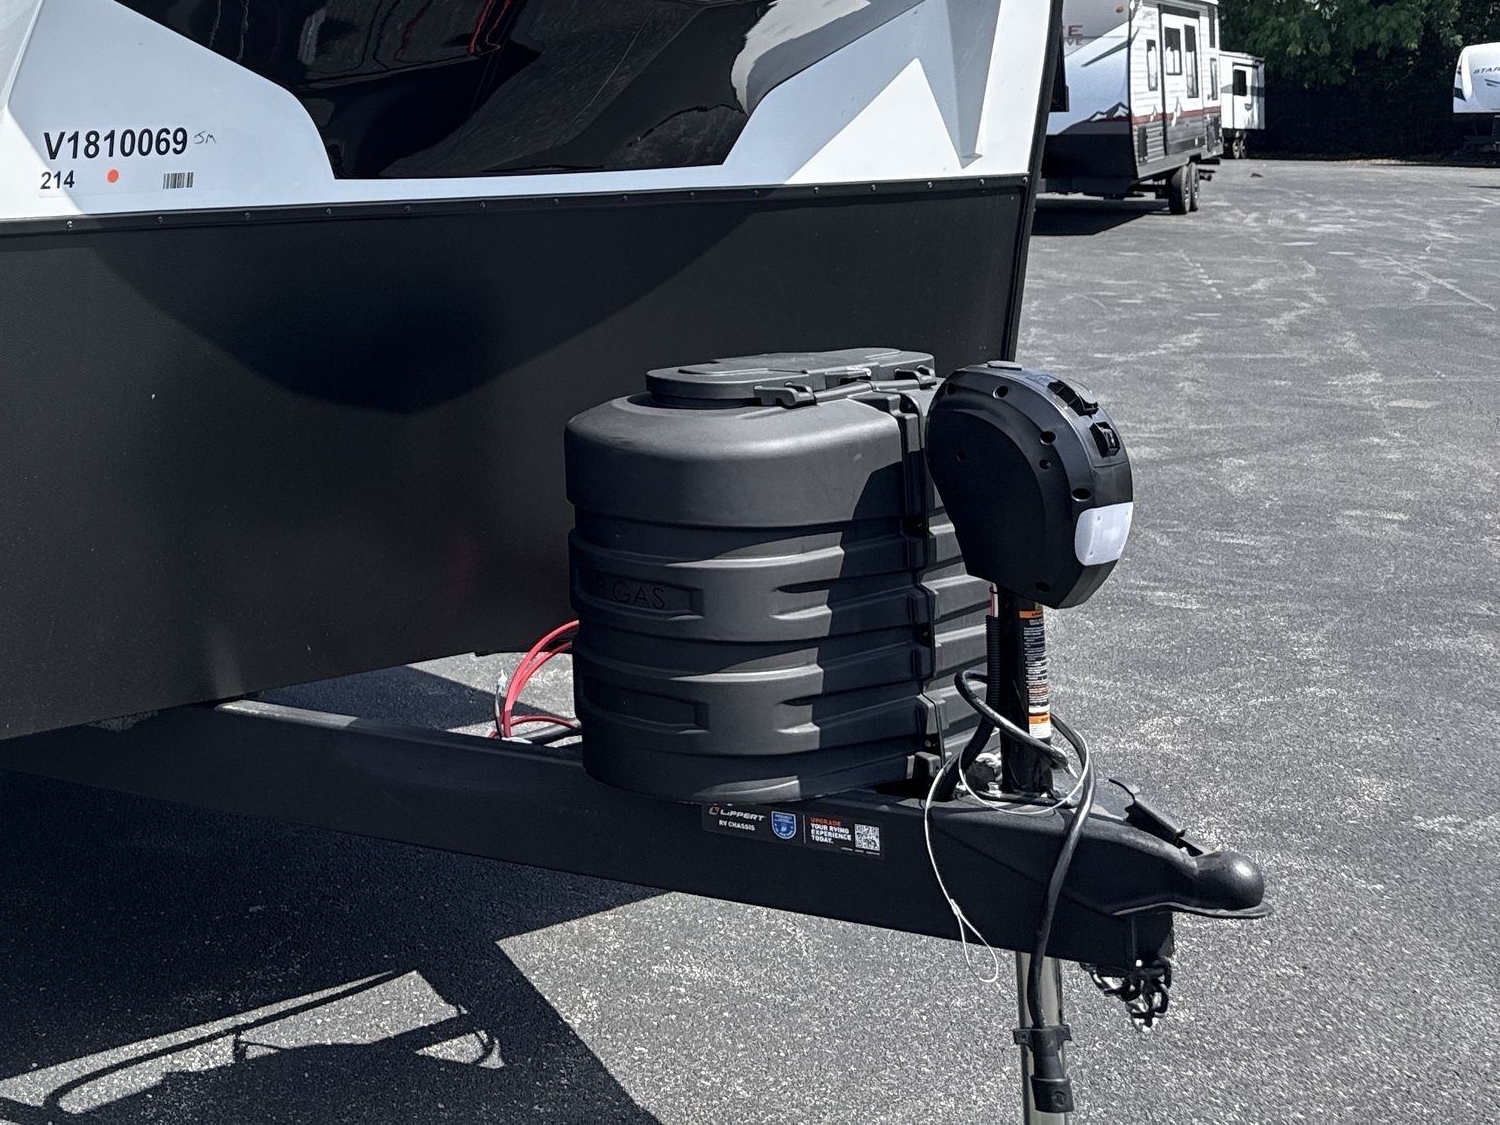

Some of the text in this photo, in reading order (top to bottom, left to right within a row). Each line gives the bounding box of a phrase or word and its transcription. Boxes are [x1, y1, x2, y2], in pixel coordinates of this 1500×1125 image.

[43, 126, 189, 160] V1810069
[39, 169, 76, 190] 214
[611, 580, 666, 610] GAS
[718, 819, 756, 832] RV CHASSIS
[810, 817, 841, 826] UPGRADE
[810, 823, 828, 831] YOUR
[810, 828, 852, 842] EXPERIENCE
